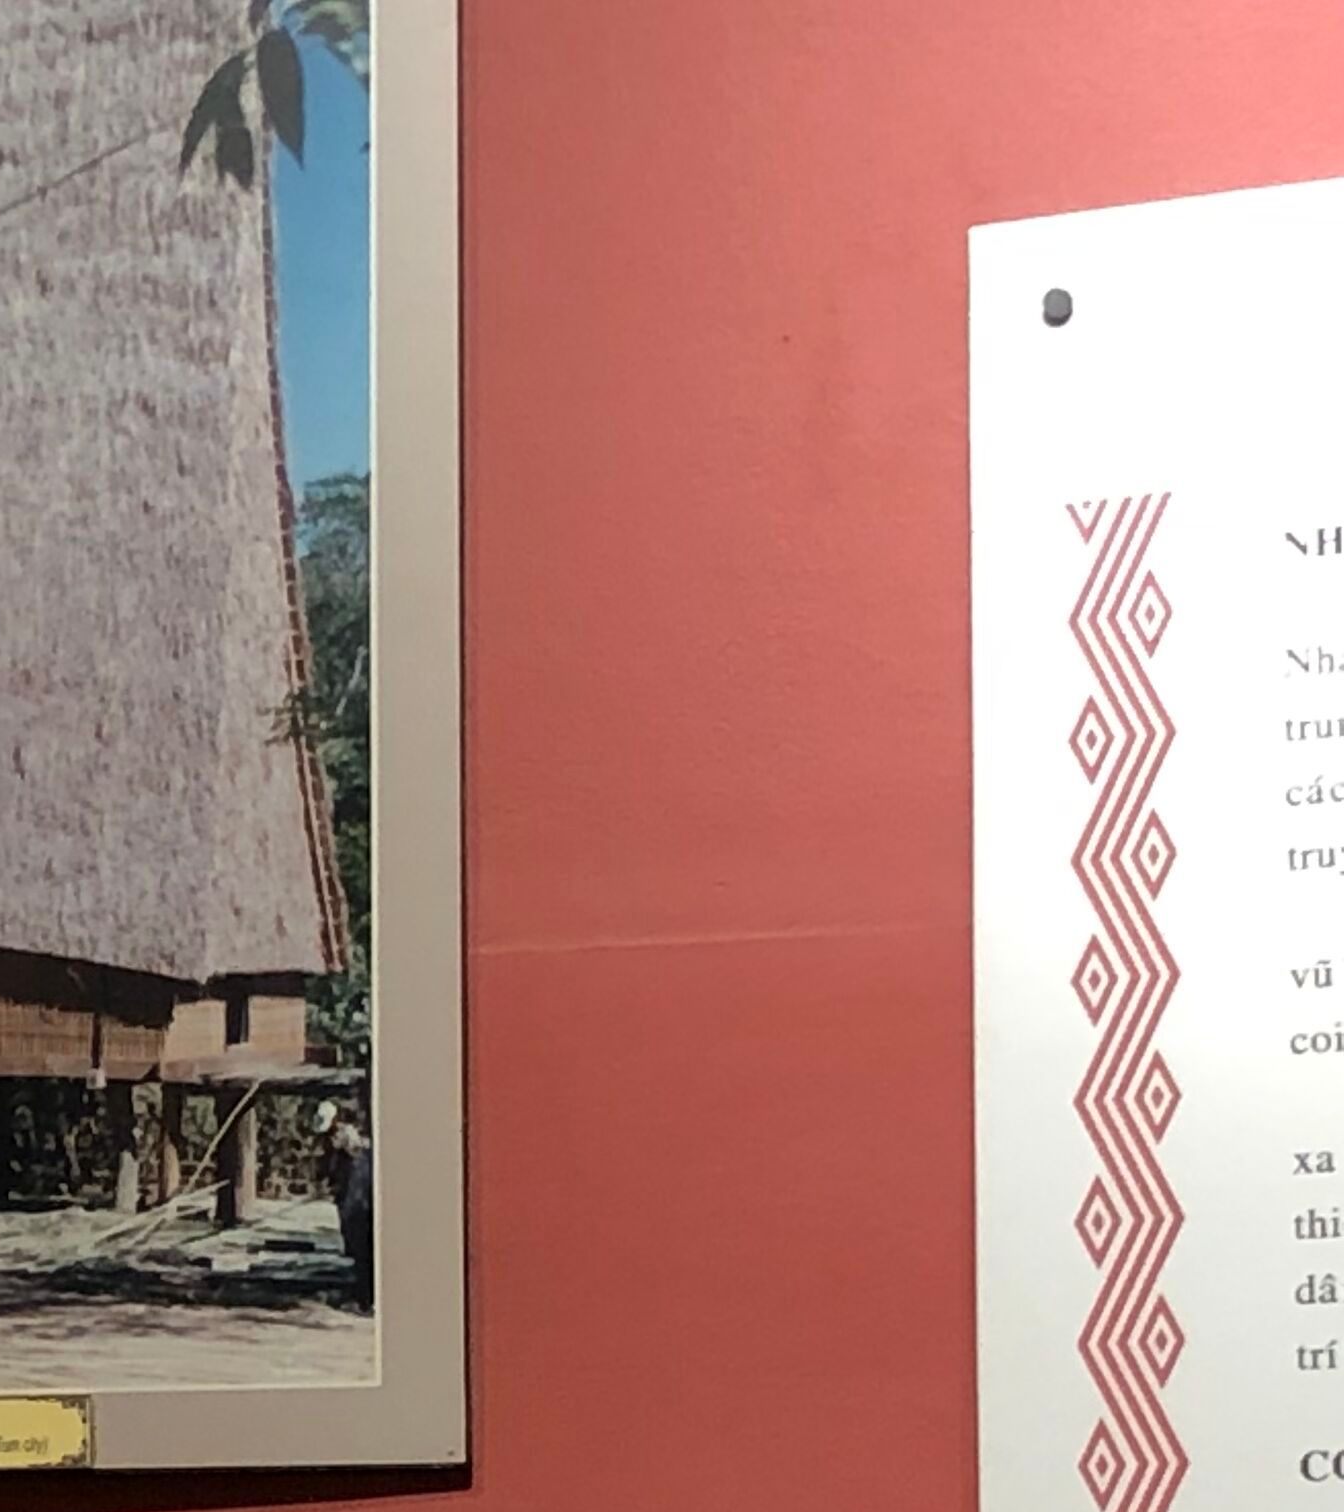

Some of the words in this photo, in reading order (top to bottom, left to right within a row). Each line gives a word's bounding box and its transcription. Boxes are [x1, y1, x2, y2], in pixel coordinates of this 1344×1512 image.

[1286, 645, 1344, 675] Nh
[1288, 846, 1344, 877] tru
[1289, 959, 1334, 990] vũ
[1292, 1150, 1337, 1176] xa
[1293, 1206, 1344, 1241] thi
[1295, 1338, 1339, 1371] trí
